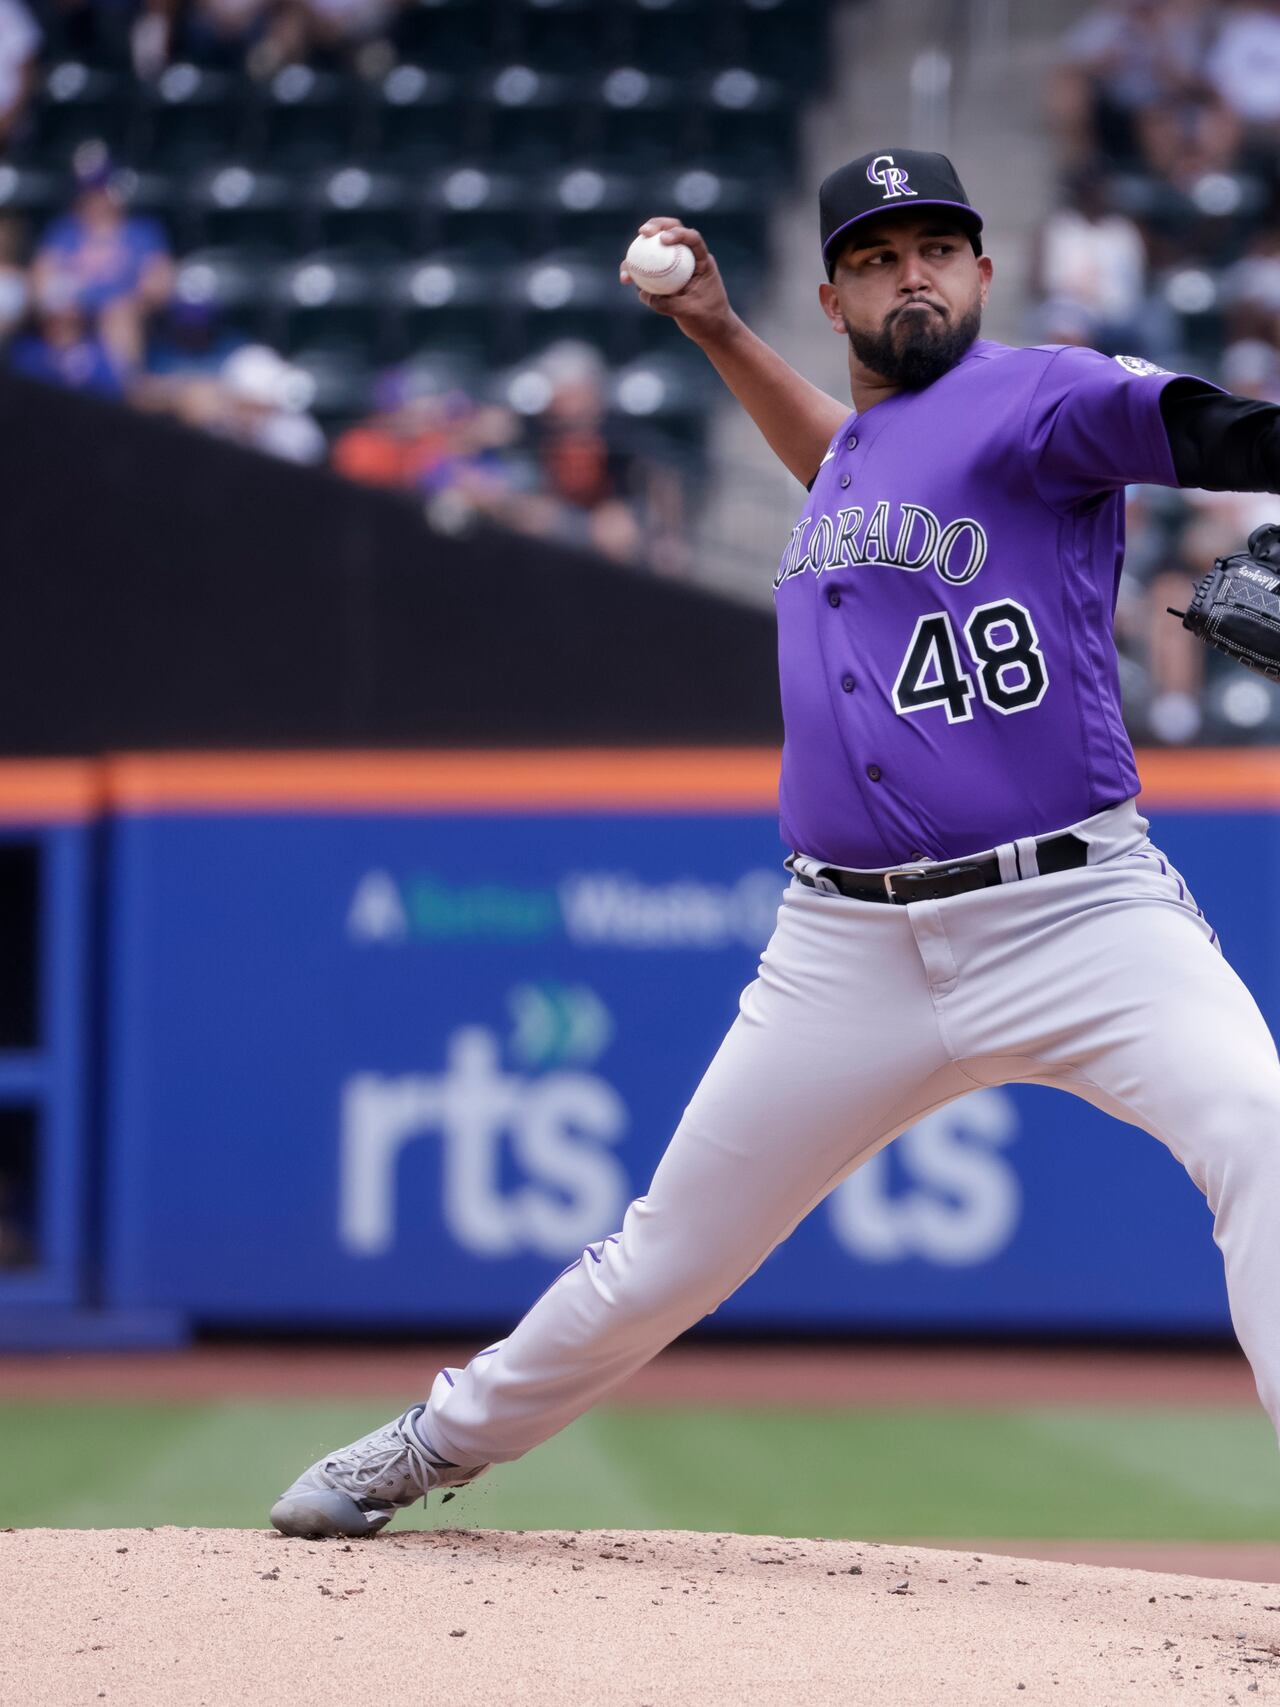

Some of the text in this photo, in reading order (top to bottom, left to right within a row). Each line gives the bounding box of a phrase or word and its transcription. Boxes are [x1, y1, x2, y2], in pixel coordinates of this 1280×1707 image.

[866, 156, 918, 199] CR
[892, 598, 1050, 724] 48
[341, 1028, 627, 1260] rts
